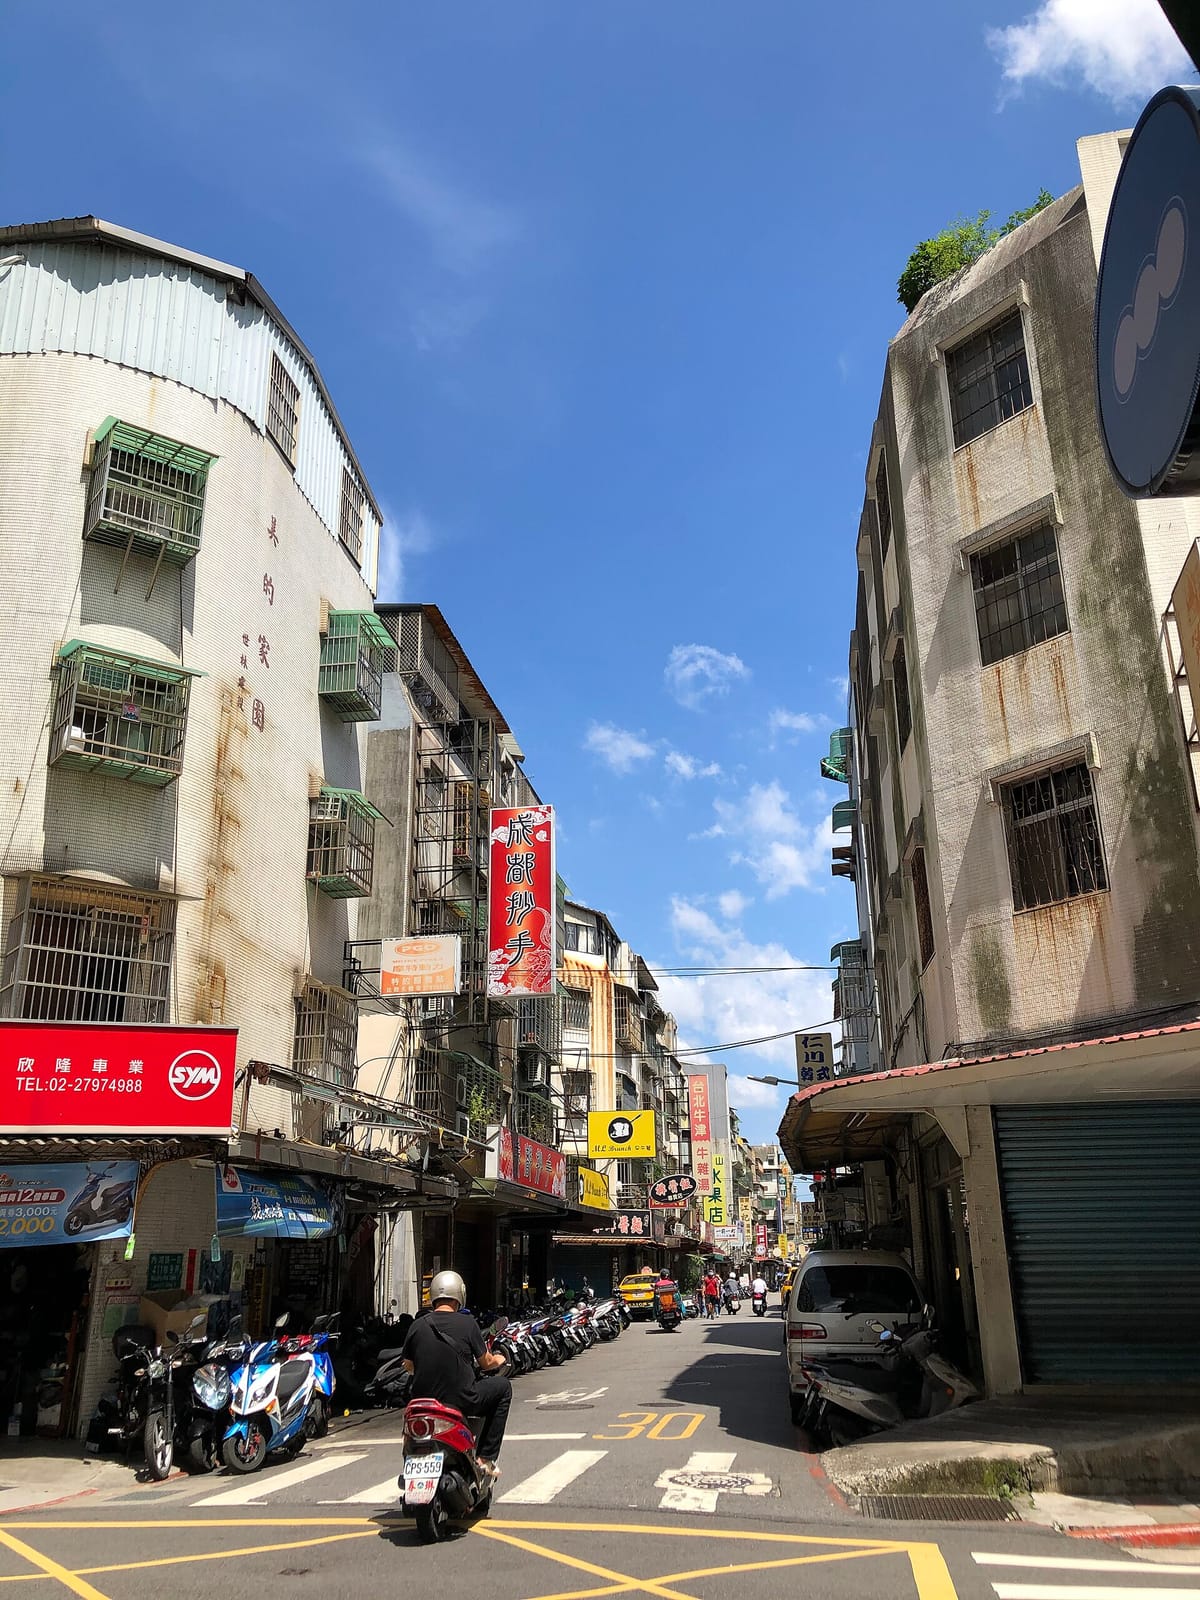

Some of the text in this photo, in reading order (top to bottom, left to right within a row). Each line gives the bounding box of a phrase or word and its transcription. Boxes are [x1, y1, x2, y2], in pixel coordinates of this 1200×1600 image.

[505, 813, 537, 967] 成都抄手
[17, 1057, 144, 1074] 欣隆車業
[15, 1077, 143, 1093] TEL:02-27974988
[171, 1066, 219, 1089] SYM
[608, 1144, 632, 1152] Brunch
[696, 1147, 710, 1191] 牛雜湯
[592, 1412, 706, 1440] 30
[404, 1461, 442, 1475] CPS-559
